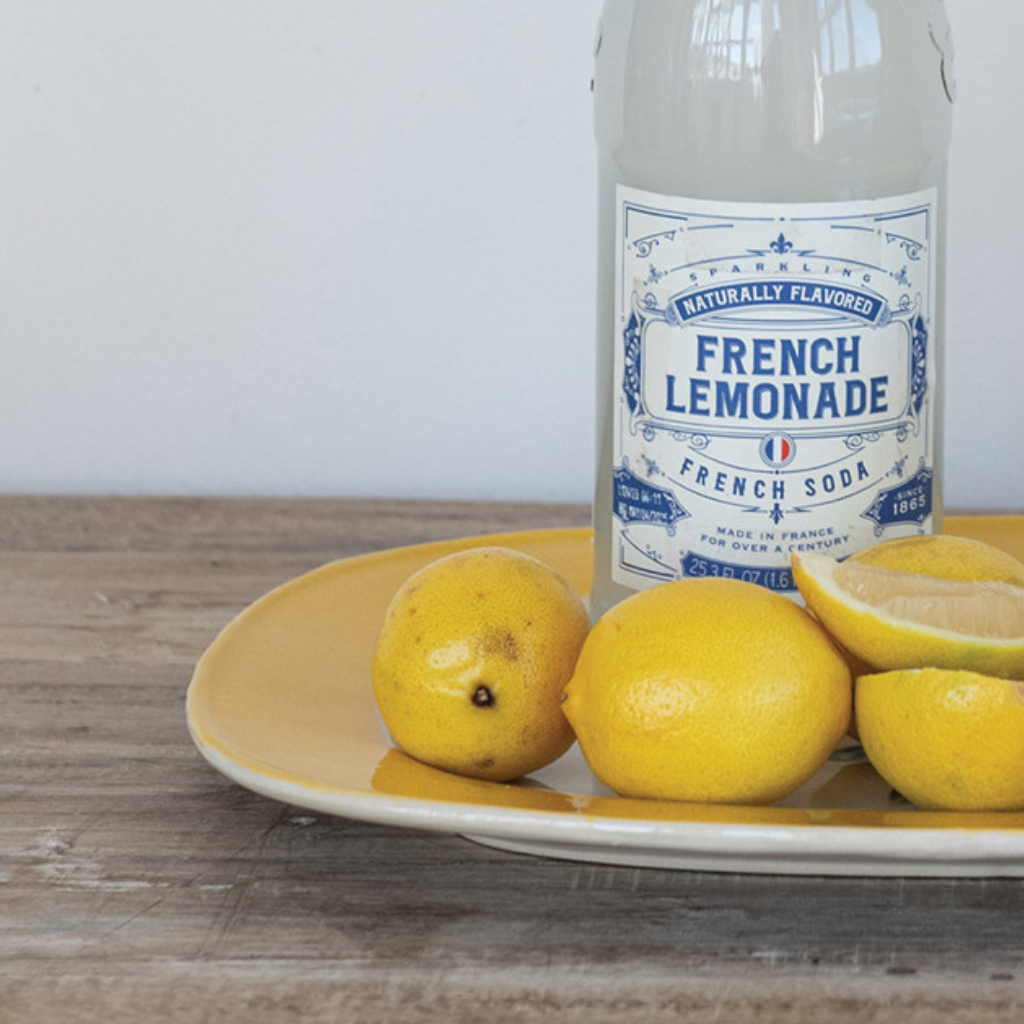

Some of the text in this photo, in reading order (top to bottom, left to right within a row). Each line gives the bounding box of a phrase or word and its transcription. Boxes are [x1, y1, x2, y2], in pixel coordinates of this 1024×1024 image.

[689, 262, 871, 283] SPARKLING
[682, 284, 875, 318] NATURALLY FLAVORED
[696, 334, 861, 376] FRENCH
[665, 374, 889, 420] LEMONADE
[679, 457, 786, 500] FRENCH
[805, 460, 871, 497] SODA
[893, 493, 926, 516] 1865
[700, 534, 850, 553] FOR OVER A CENTURY
[716, 526, 835, 541] MADE IN FRANCE
[689, 558, 720, 578] 253
